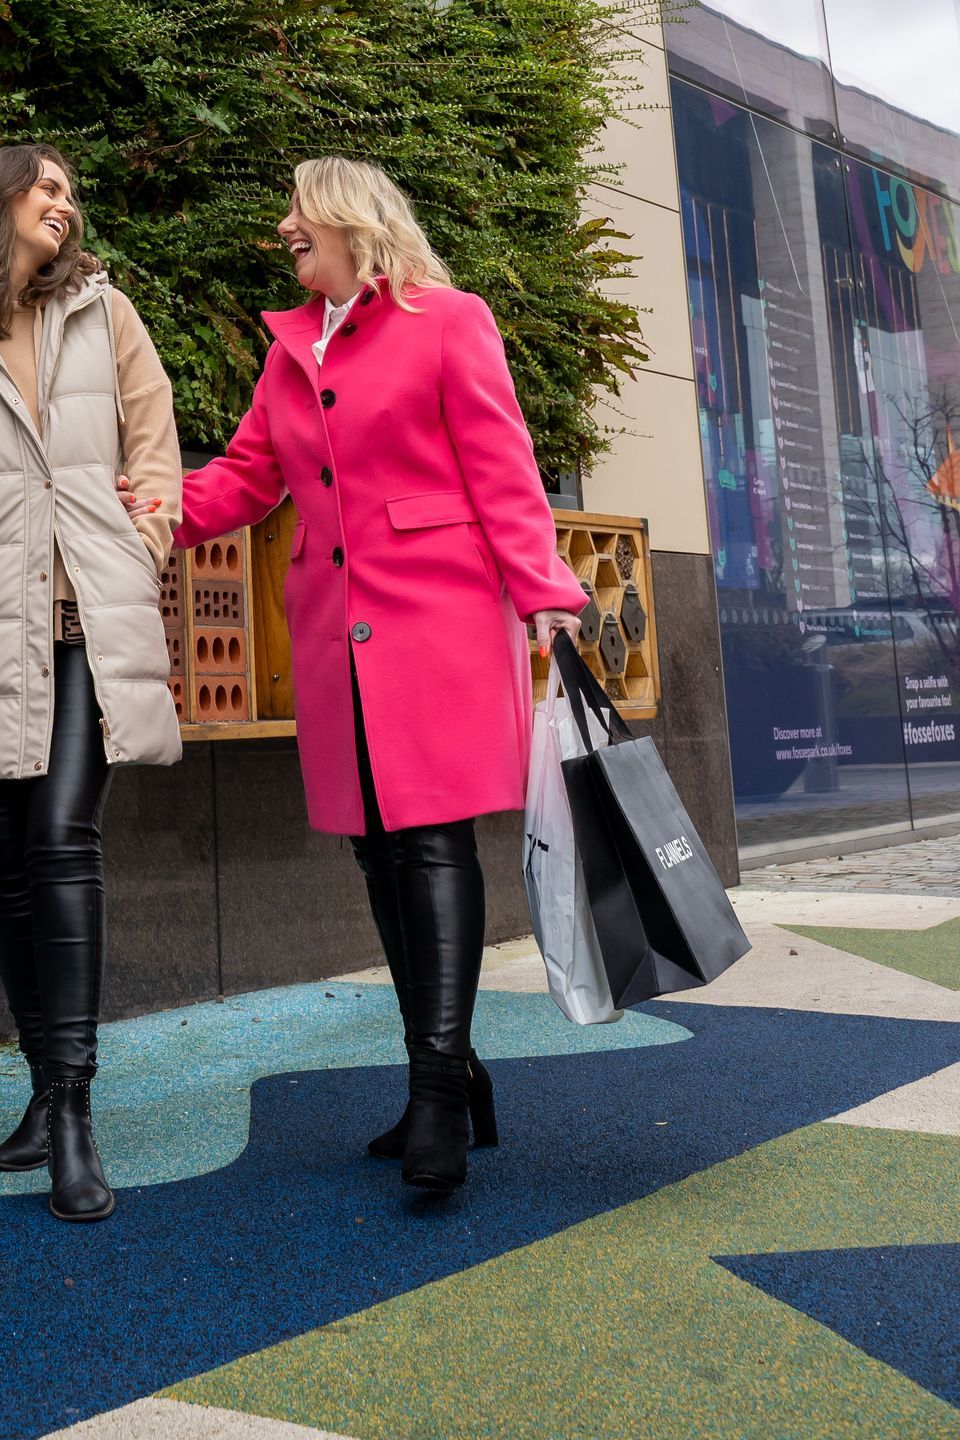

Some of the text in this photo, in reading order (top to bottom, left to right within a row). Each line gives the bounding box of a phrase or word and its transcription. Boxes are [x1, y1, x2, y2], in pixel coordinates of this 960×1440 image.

[905, 676, 919, 692] Snap
[923, 675, 937, 688] selfie
[937, 675, 949, 688] with
[905, 694, 952, 712] your favourite fox!
[773, 725, 823, 740] Discover more at
[903, 720, 955, 745] #fossefoxes
[775, 743, 853, 761] www.fossepark.co.uk/foxes
[654, 836, 694, 870] FLANNELS
